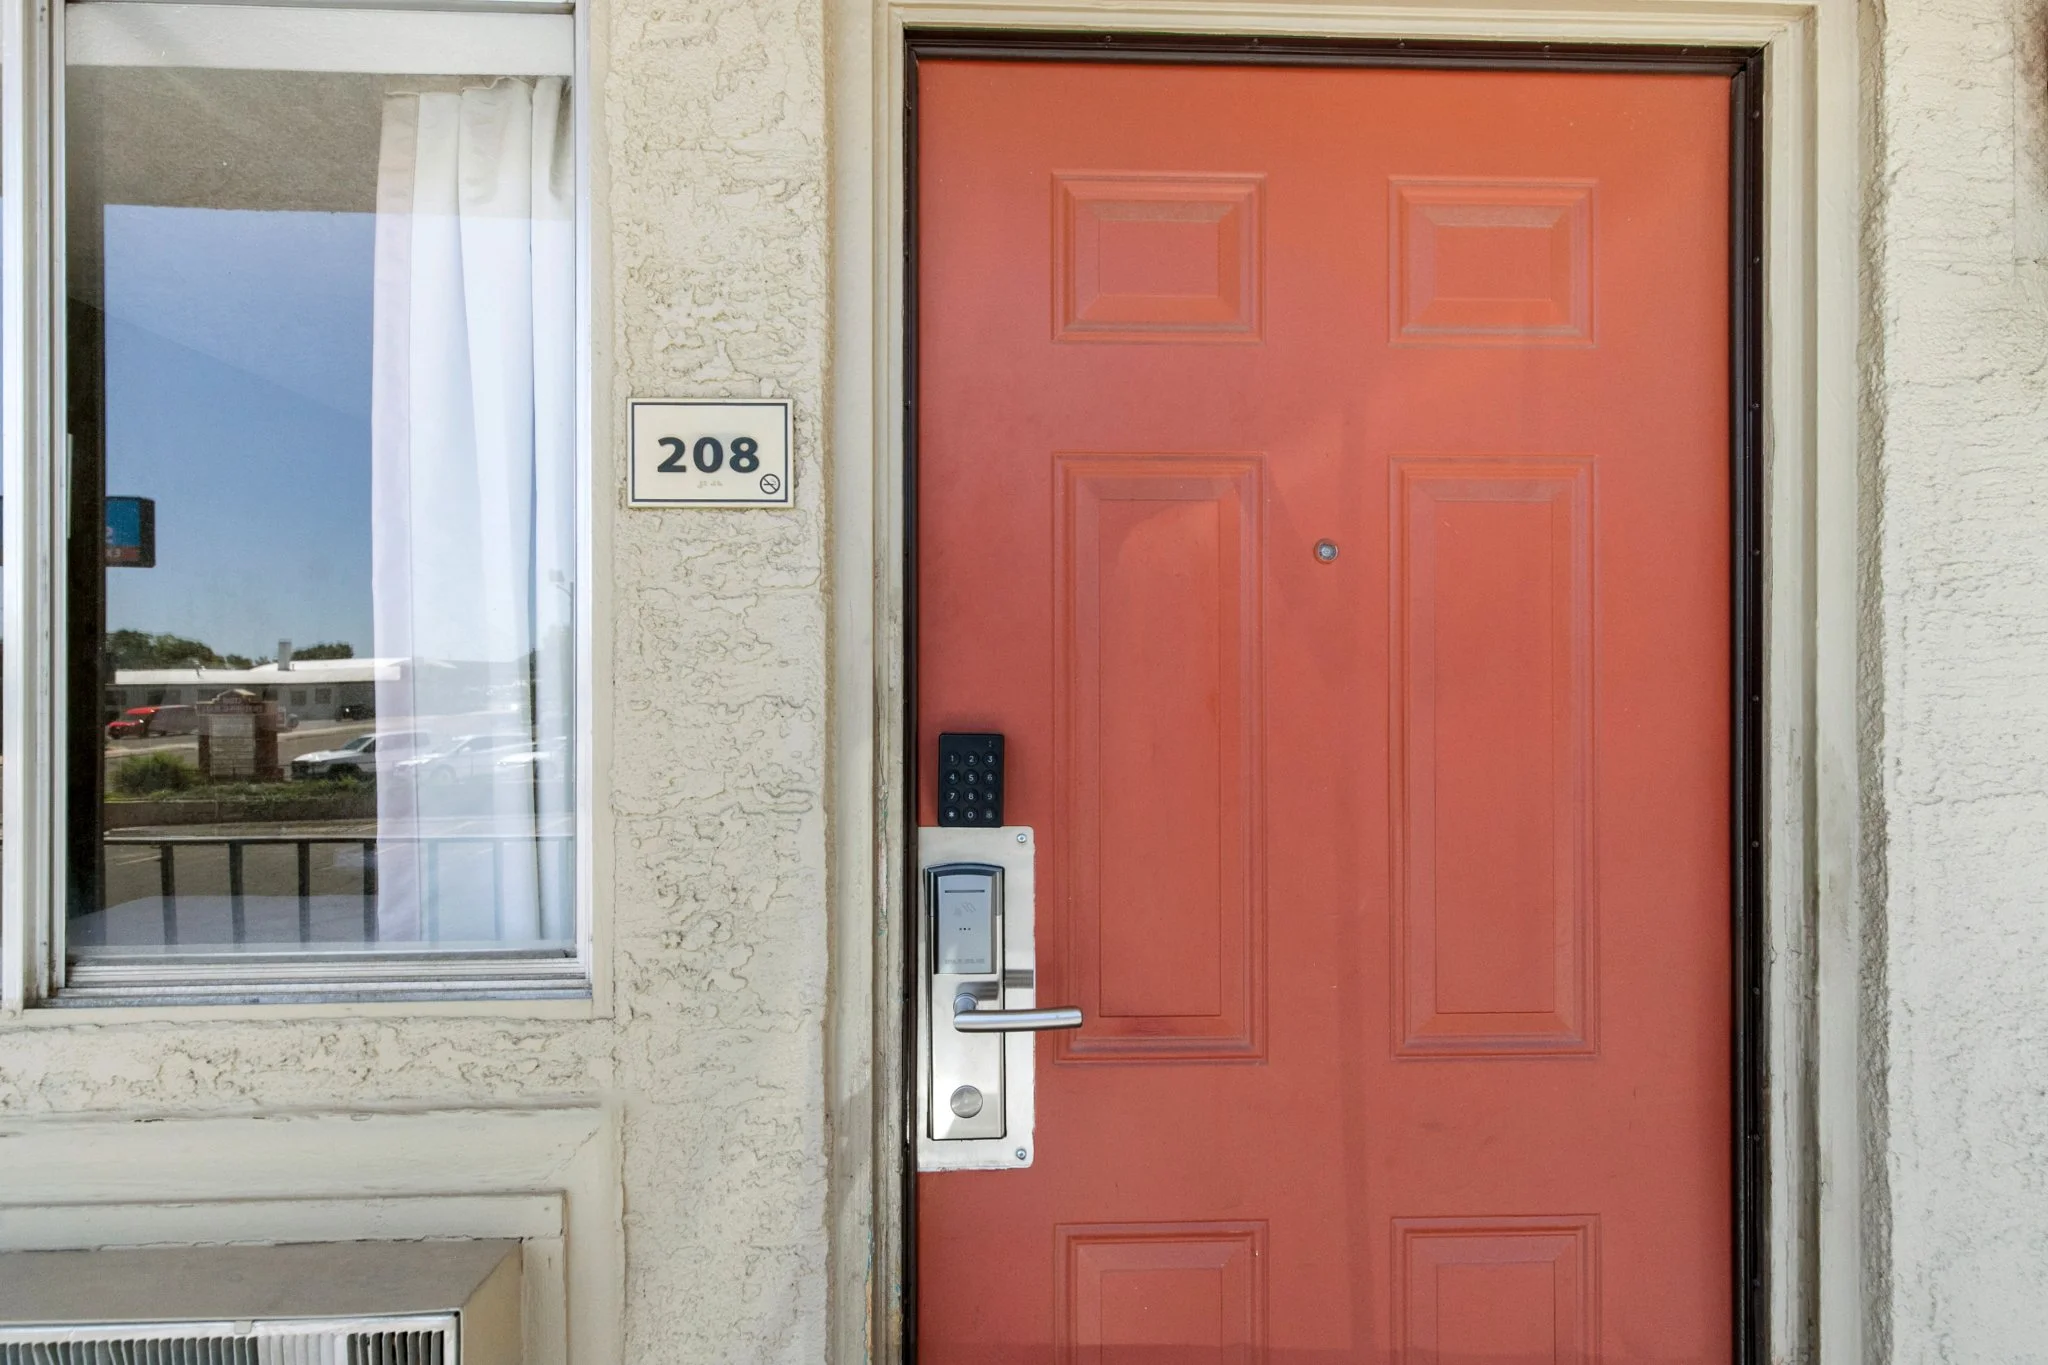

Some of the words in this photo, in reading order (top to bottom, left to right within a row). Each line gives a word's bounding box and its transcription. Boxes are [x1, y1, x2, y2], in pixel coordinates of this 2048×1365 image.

[657, 436, 760, 474] 208
[968, 755, 975, 763] 2
[987, 755, 993, 763] 3
[968, 774, 974, 782] 5
[987, 773, 993, 781] 6
[968, 792, 974, 800] 8
[987, 792, 993, 800] 9
